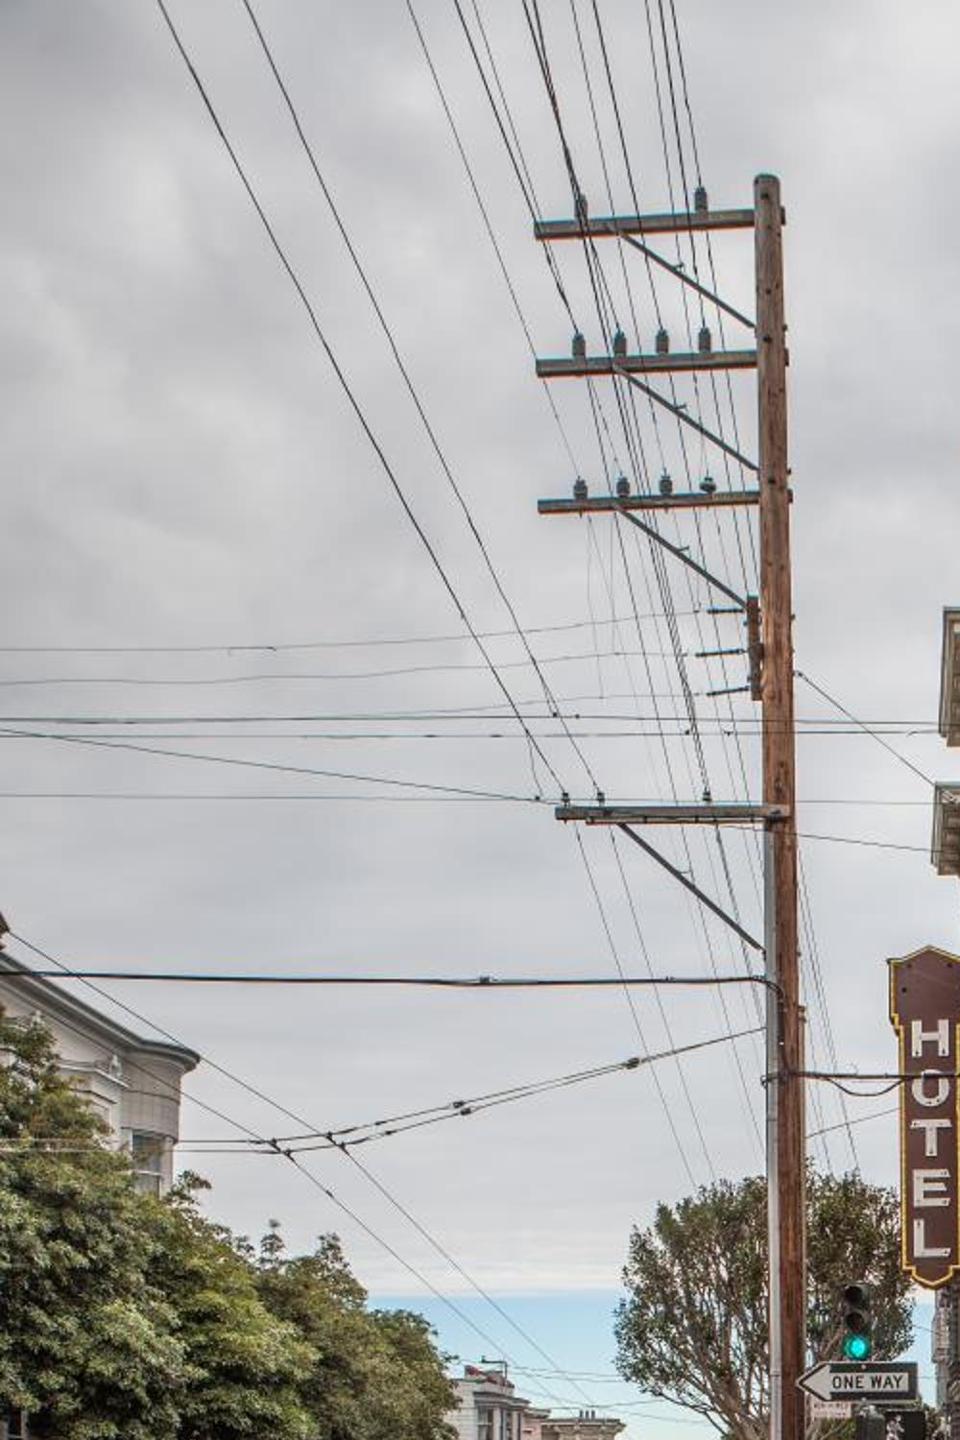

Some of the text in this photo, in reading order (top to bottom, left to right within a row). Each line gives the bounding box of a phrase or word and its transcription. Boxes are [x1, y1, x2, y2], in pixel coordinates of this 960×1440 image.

[911, 1019, 952, 1257] HOTEL
[832, 1375, 903, 1389] ONE WAY
